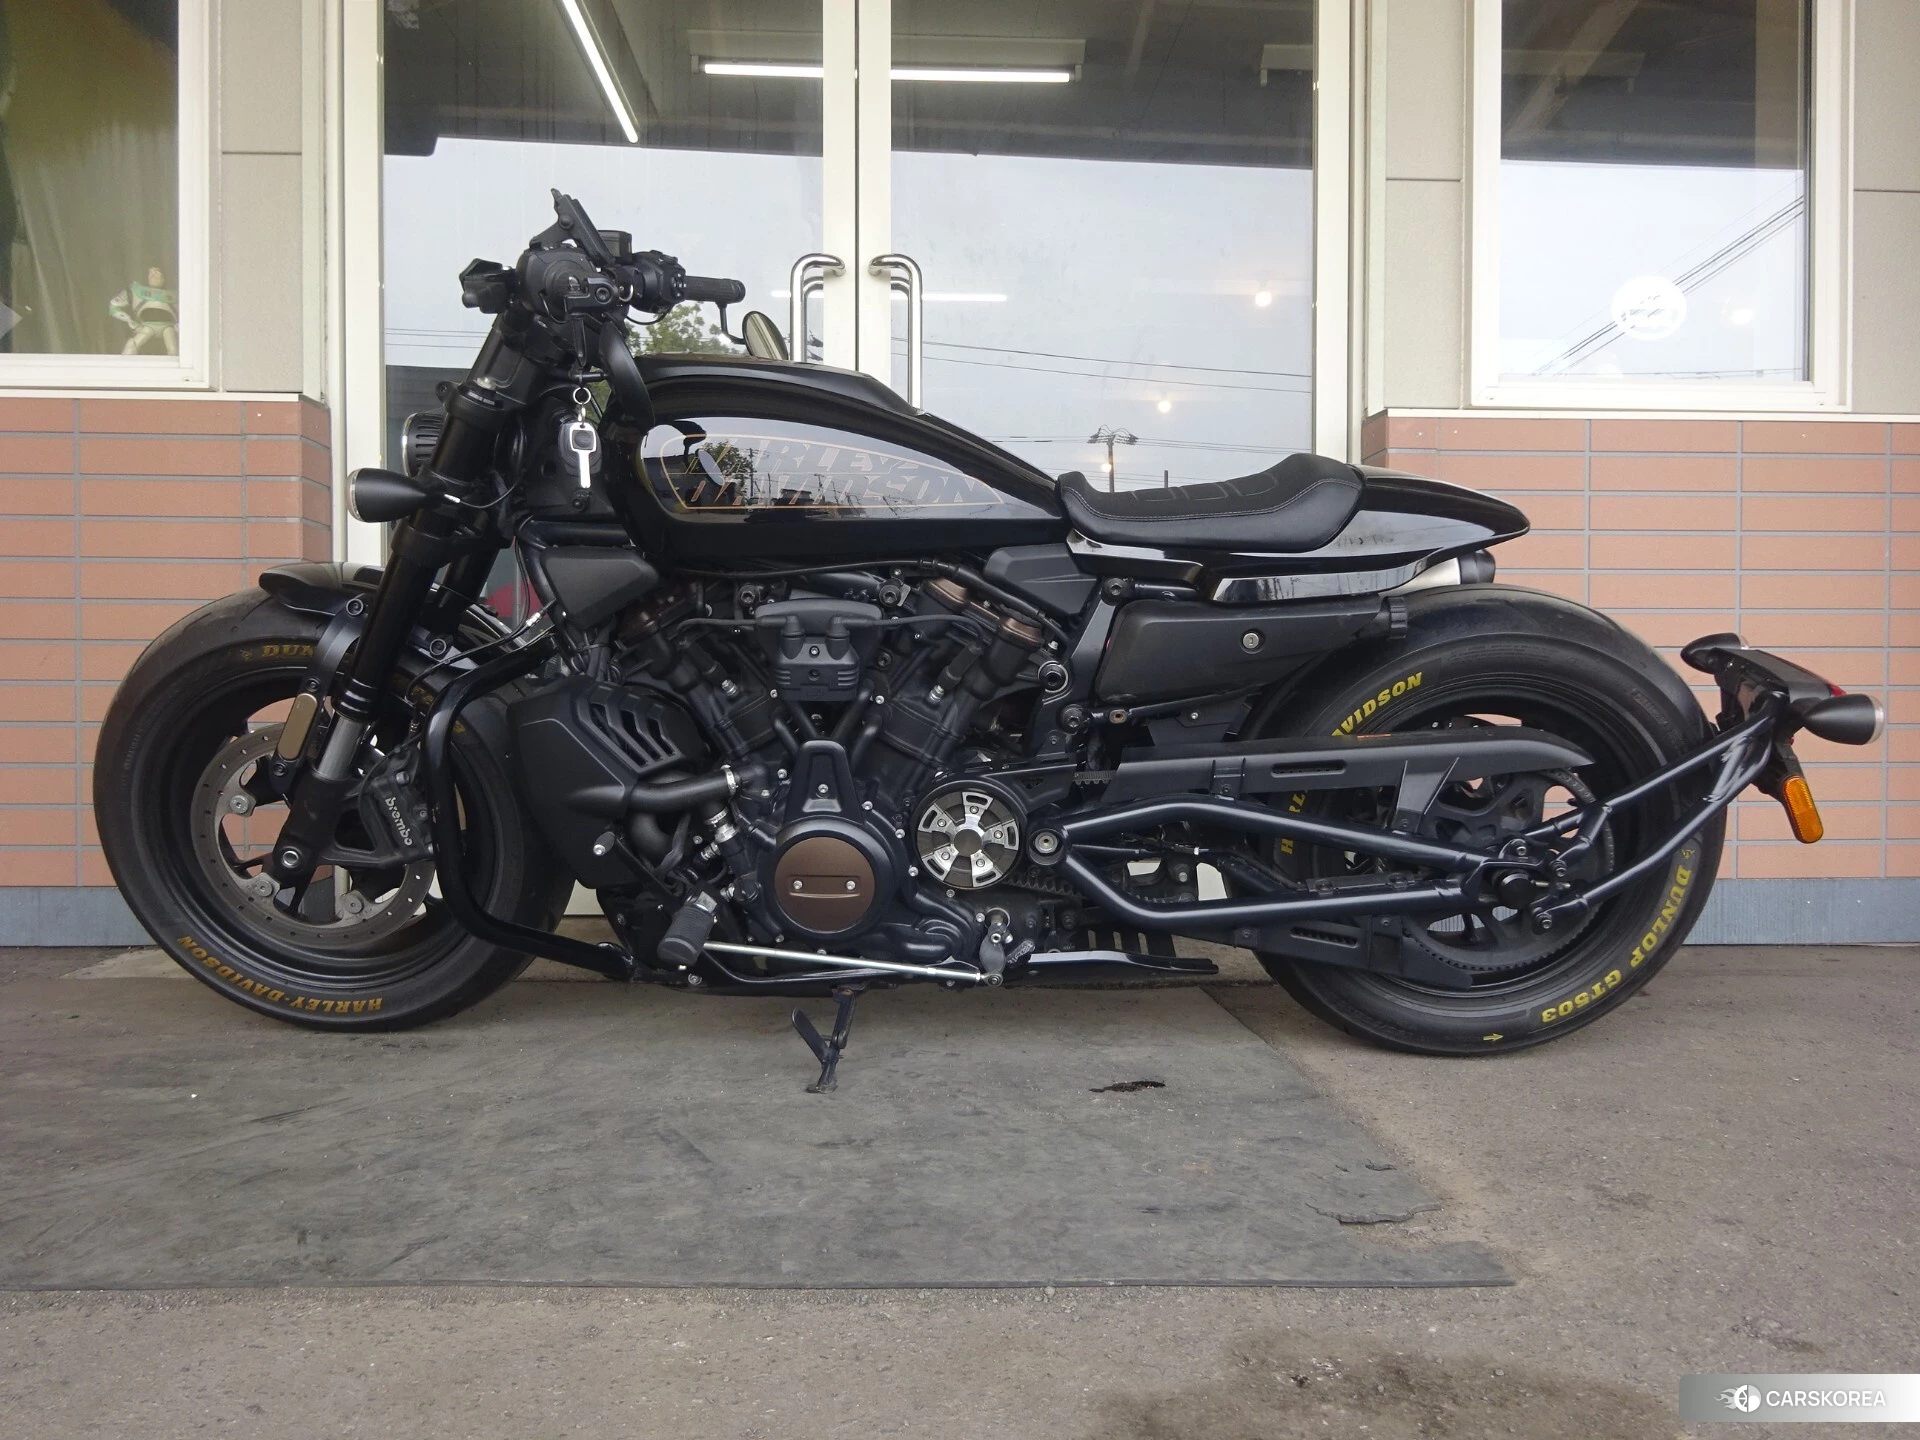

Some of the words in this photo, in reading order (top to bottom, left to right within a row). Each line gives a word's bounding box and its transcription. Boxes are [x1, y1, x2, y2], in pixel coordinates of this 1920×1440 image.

[385, 796, 413, 846] brembo
[1630, 865, 1692, 968] DUNLOP
[1541, 968, 1623, 1023] GT503
